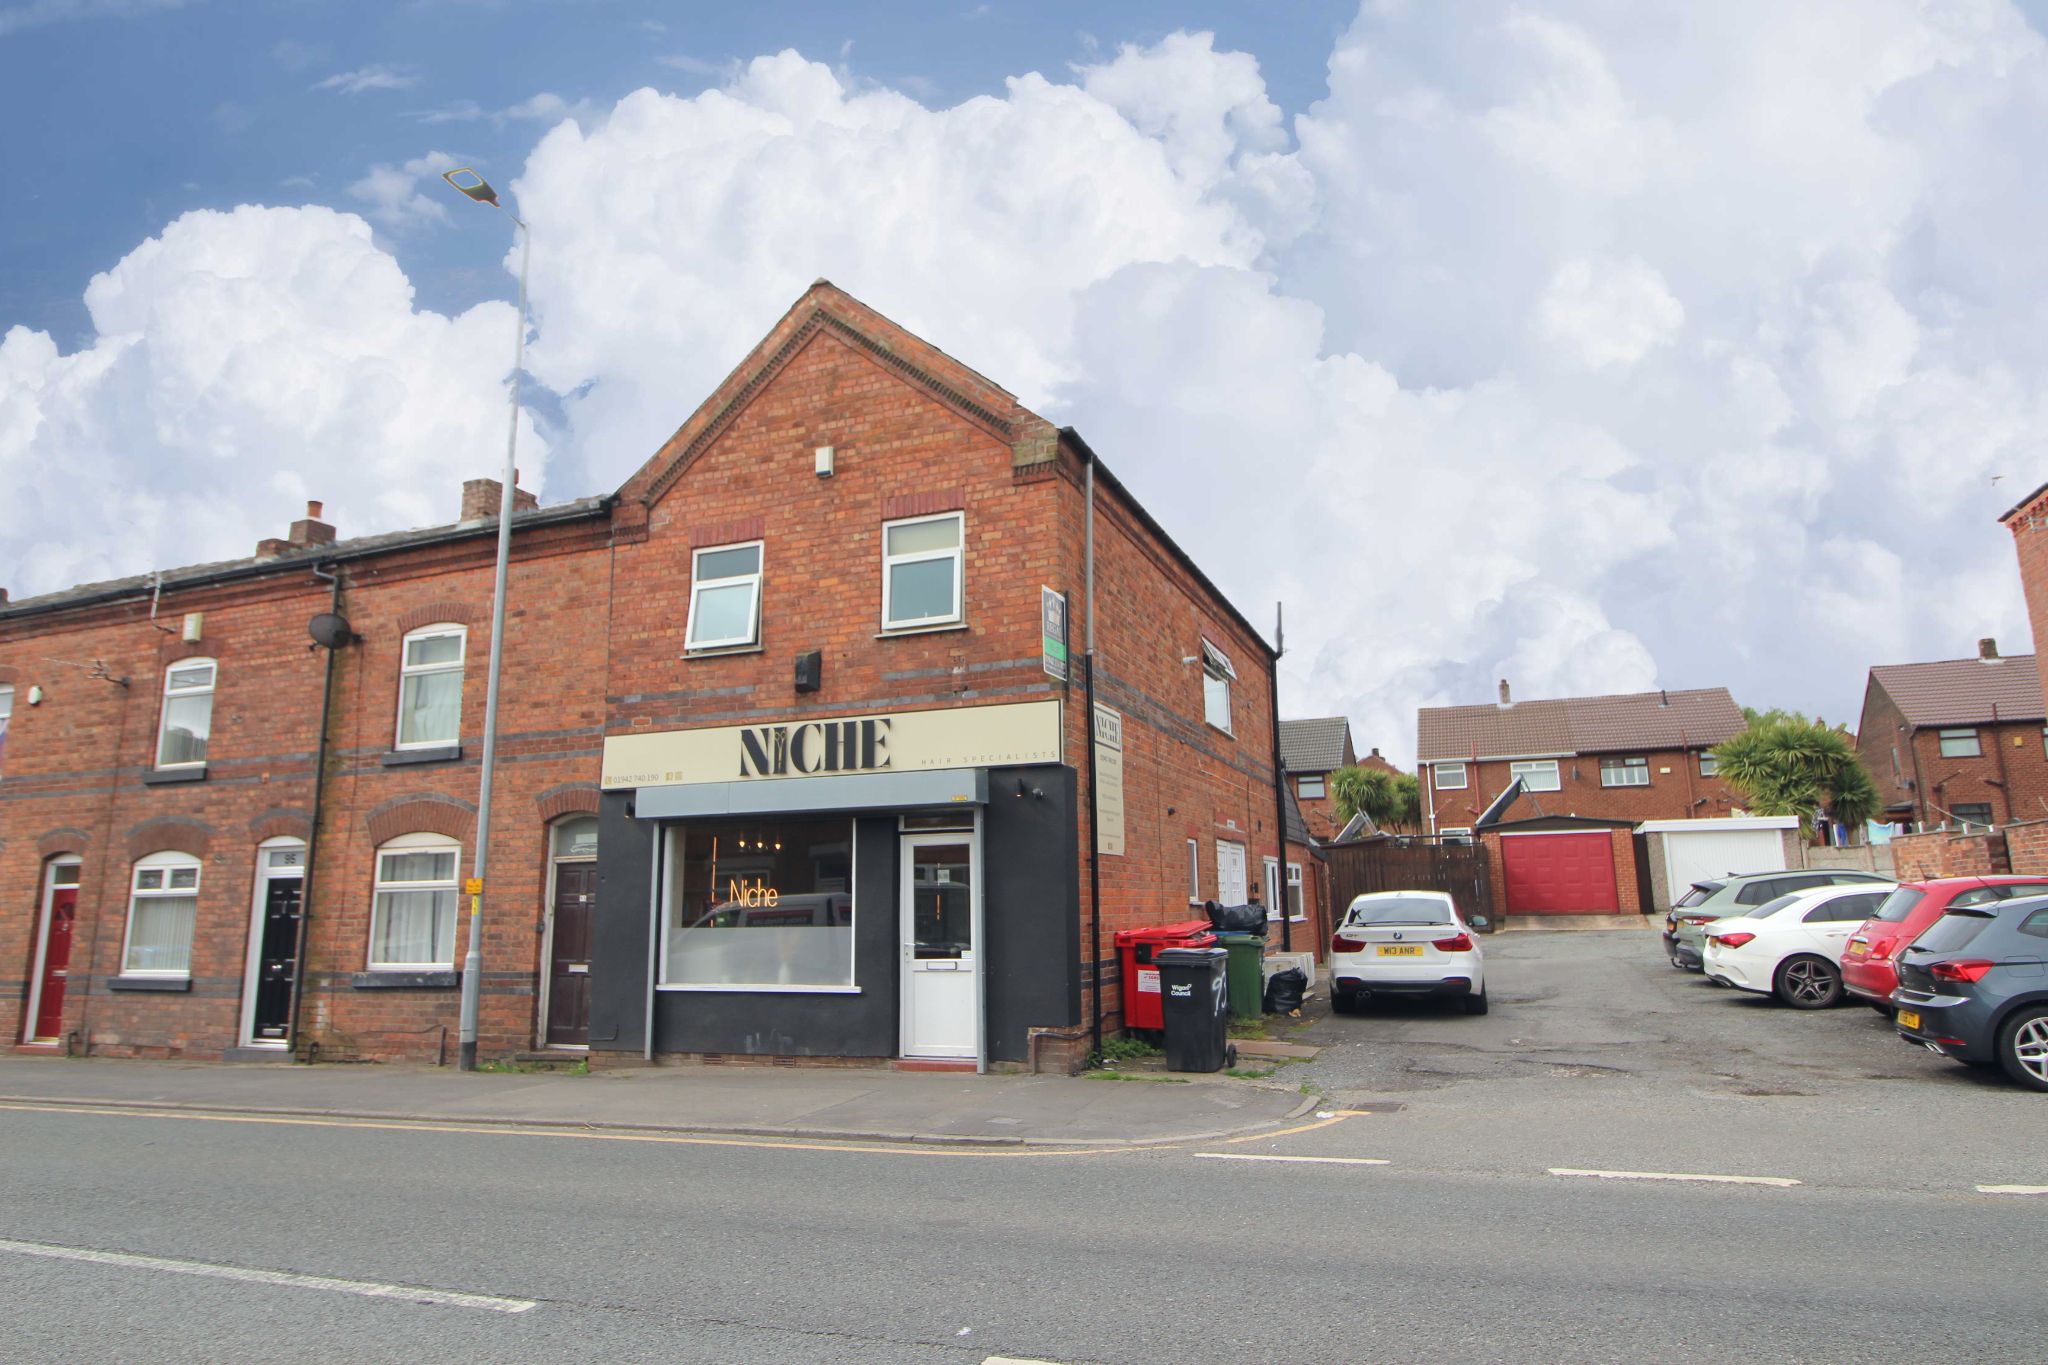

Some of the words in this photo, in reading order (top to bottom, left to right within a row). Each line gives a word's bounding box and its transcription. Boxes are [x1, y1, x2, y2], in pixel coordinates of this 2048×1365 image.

[739, 718, 891, 776] NICHE
[921, 757, 951, 765] HAIR
[963, 751, 1056, 762] SPECIALISTS
[613, 776, 632, 784] 01942
[647, 774, 660, 782] 190
[730, 878, 778, 908] Niche
[1383, 946, 1397, 955] W13
[1399, 946, 1415, 955] ANR
